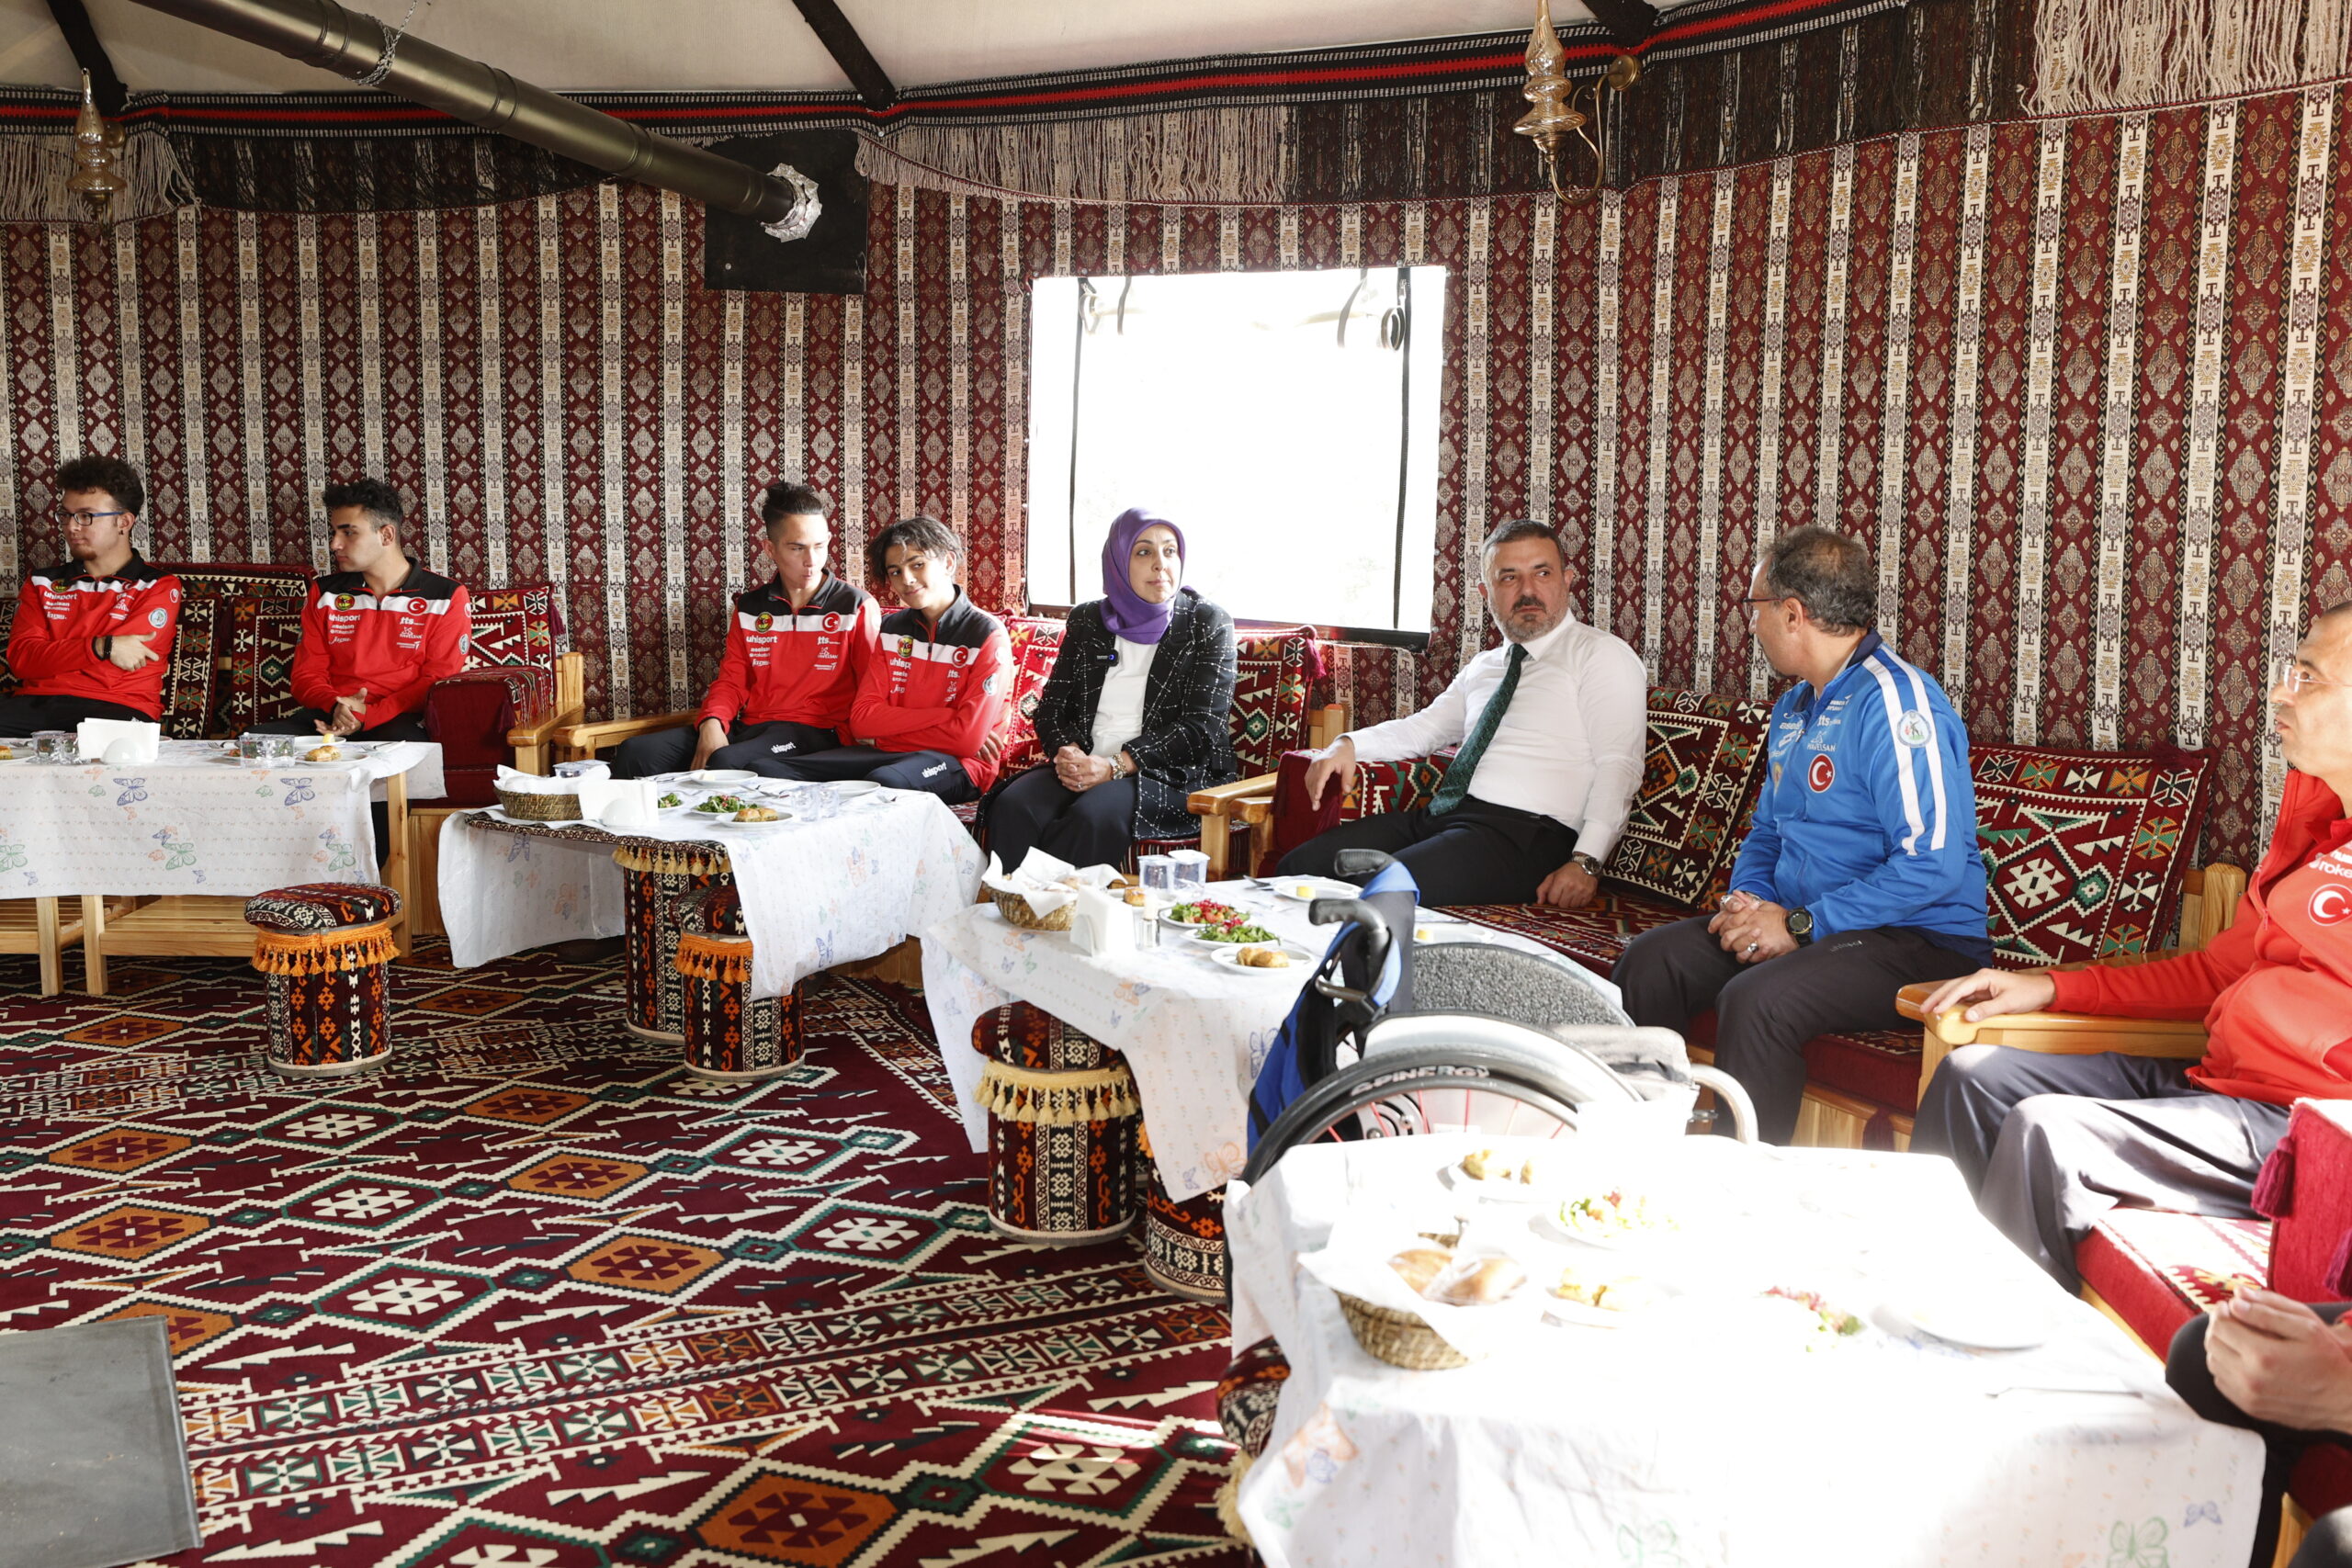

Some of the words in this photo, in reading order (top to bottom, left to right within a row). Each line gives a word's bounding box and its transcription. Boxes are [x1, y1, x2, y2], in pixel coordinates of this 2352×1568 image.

[746, 635, 777, 644] uhlsport
[1807, 743, 1836, 751] HAVELSAN
[922, 761, 947, 778] uhlsport
